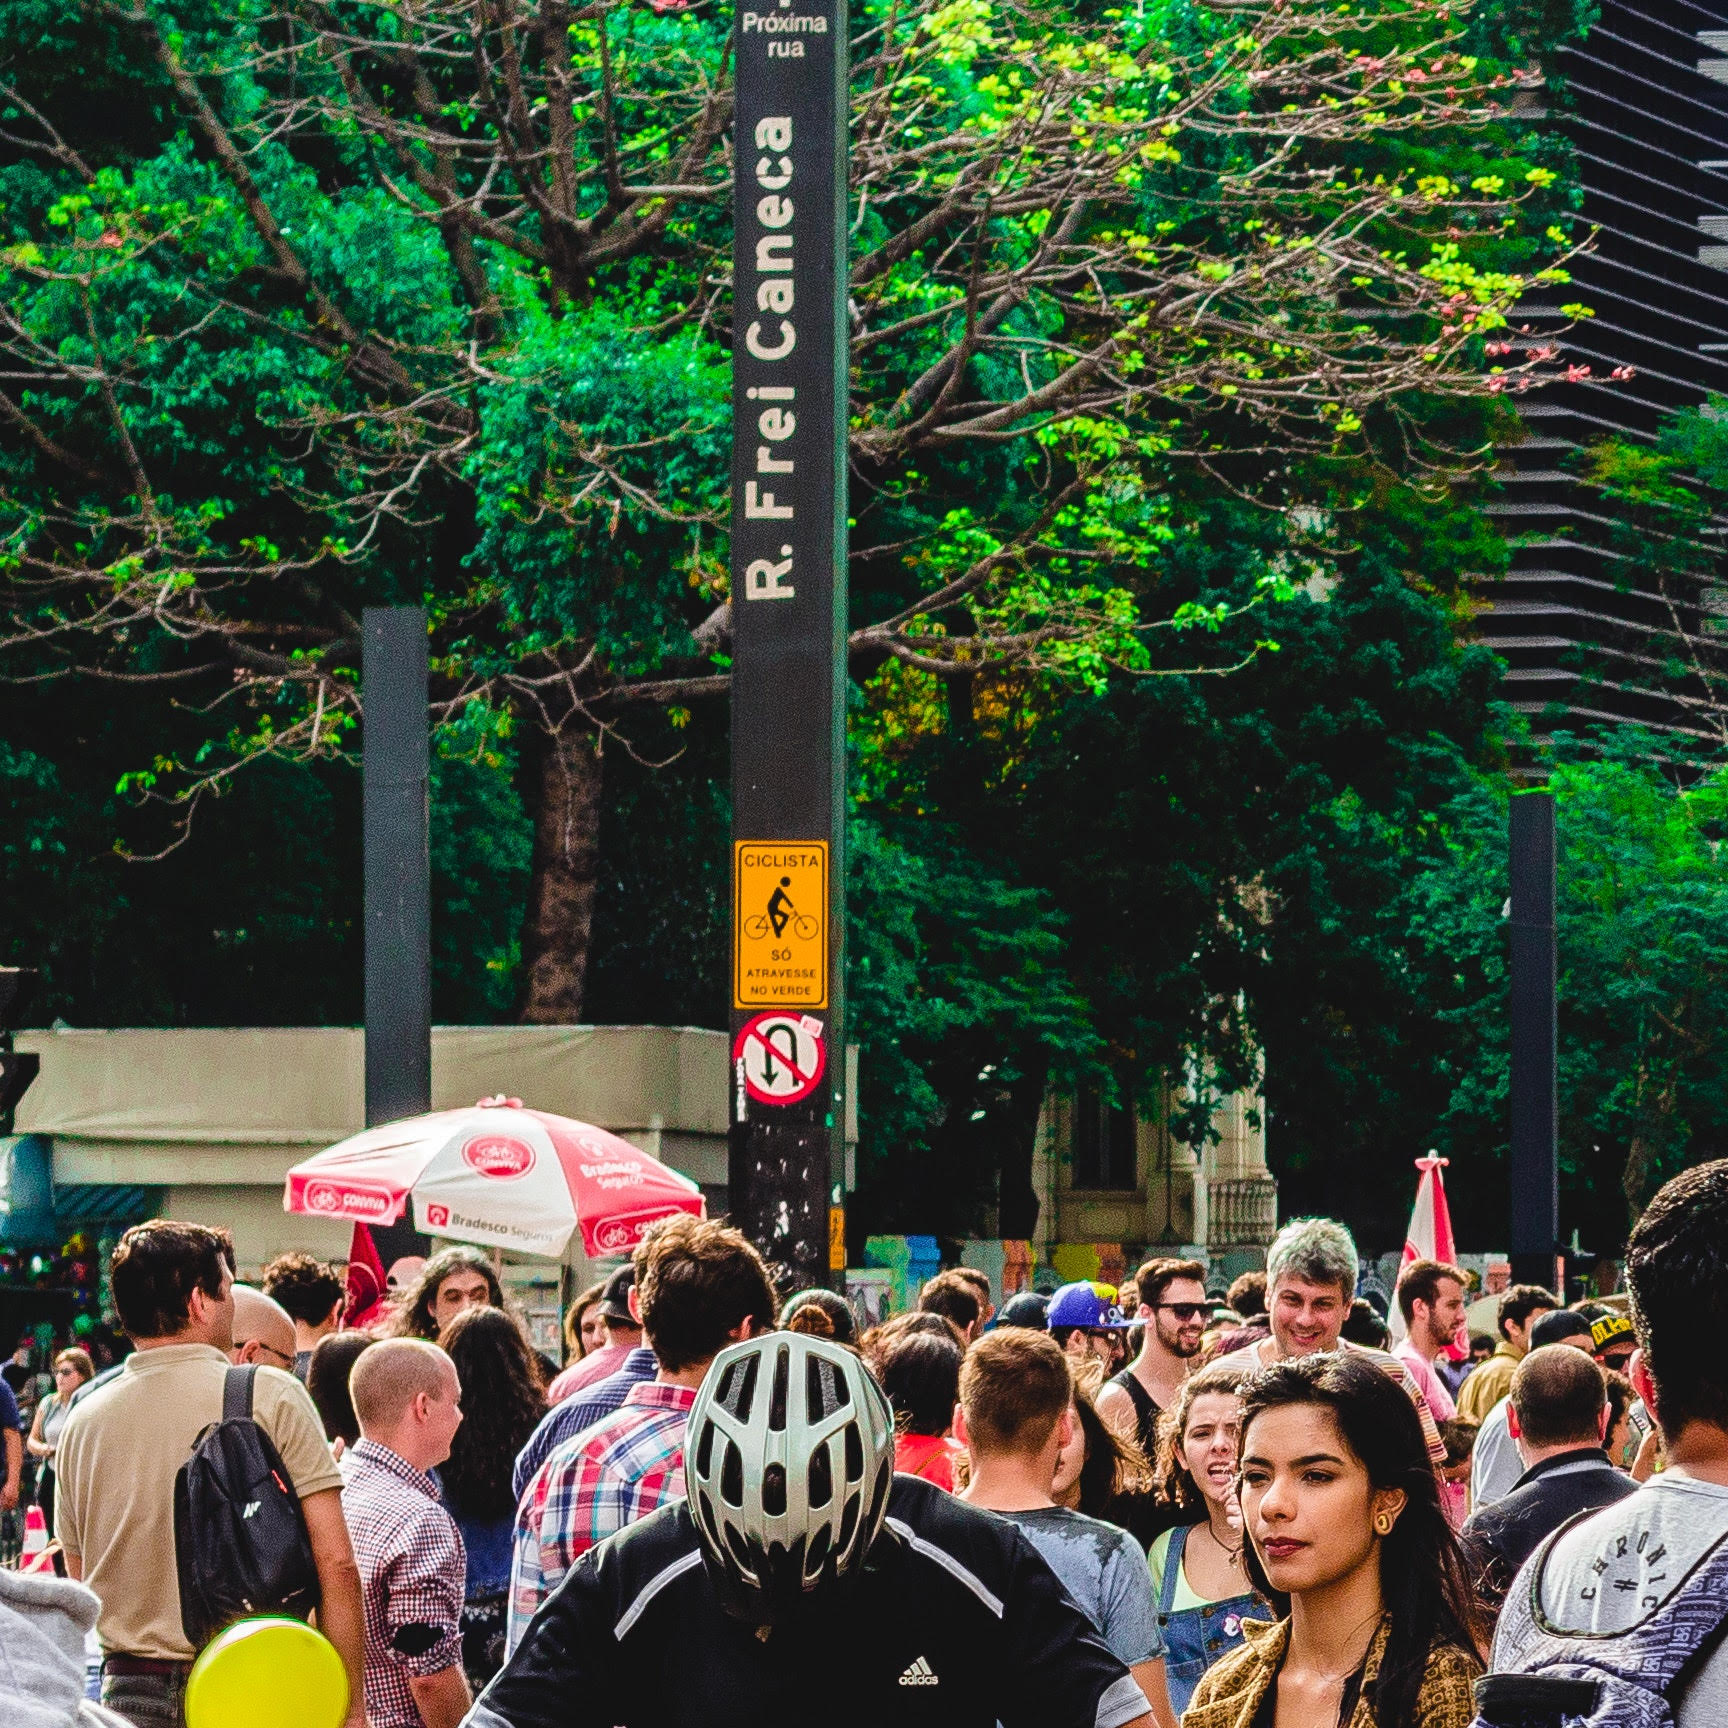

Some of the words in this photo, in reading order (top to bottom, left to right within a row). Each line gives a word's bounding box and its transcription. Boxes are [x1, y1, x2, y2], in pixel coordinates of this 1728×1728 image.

[742, 11, 827, 37] Próxima
[767, 38, 805, 58] rua
[745, 114, 796, 362] Caneca
[745, 386, 796, 520] Frei
[745, 543, 796, 601] R.
[744, 854, 819, 868] CICLISTA
[771, 946, 792, 961] SÓ
[746, 969, 817, 979] ATRAVESSE
[750, 985, 768, 996] NO
[771, 985, 811, 996] VERDE
[343, 1192, 386, 1211] CONVIVA
[451, 1213, 508, 1235] Bradesco
[510, 1224, 553, 1243] Seguros
[1580, 1530, 1667, 1609] CHRONIC
[898, 1674, 939, 1686] adidas
